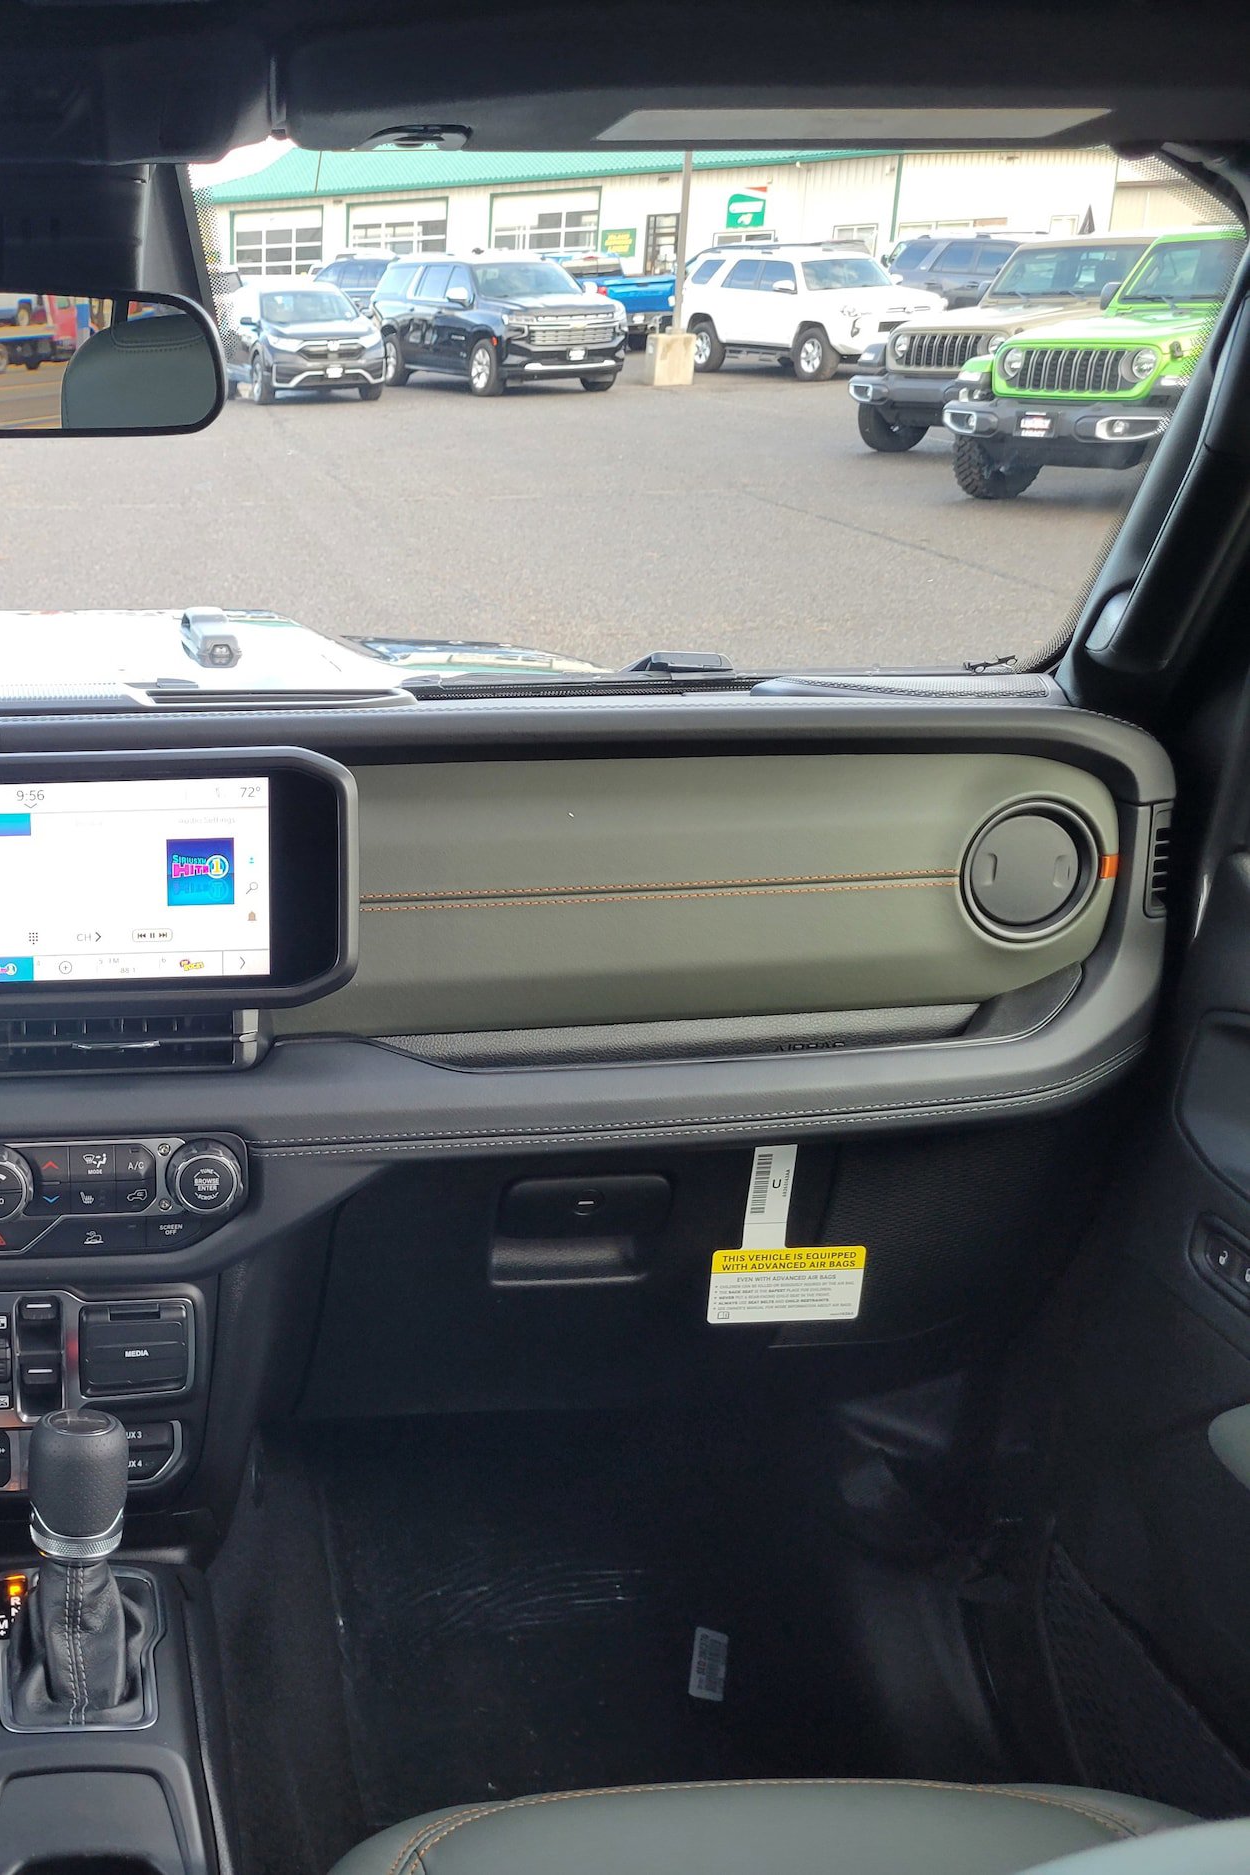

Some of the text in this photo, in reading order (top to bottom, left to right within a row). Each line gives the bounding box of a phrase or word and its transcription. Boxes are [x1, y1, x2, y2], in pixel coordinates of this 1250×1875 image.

[16, 790, 45, 802] 9:56
[240, 786, 261, 798] 72°
[76, 933, 92, 942] CH
[128, 1162, 144, 1170] A/C
[748, 1254, 790, 1262] VEHICLE
[794, 1252, 802, 1260] IS
[806, 1252, 857, 1260] EQUIPPED
[722, 1263, 748, 1271] WITH
[750, 1262, 806, 1270] ADVANCED
[829, 1260, 856, 1268] BAGS
[124, 1350, 149, 1358] MEDIA
[128, 1460, 136, 1468] UX
[10, 1586, 21, 1596] P
[10, 1596, 22, 1606] R
